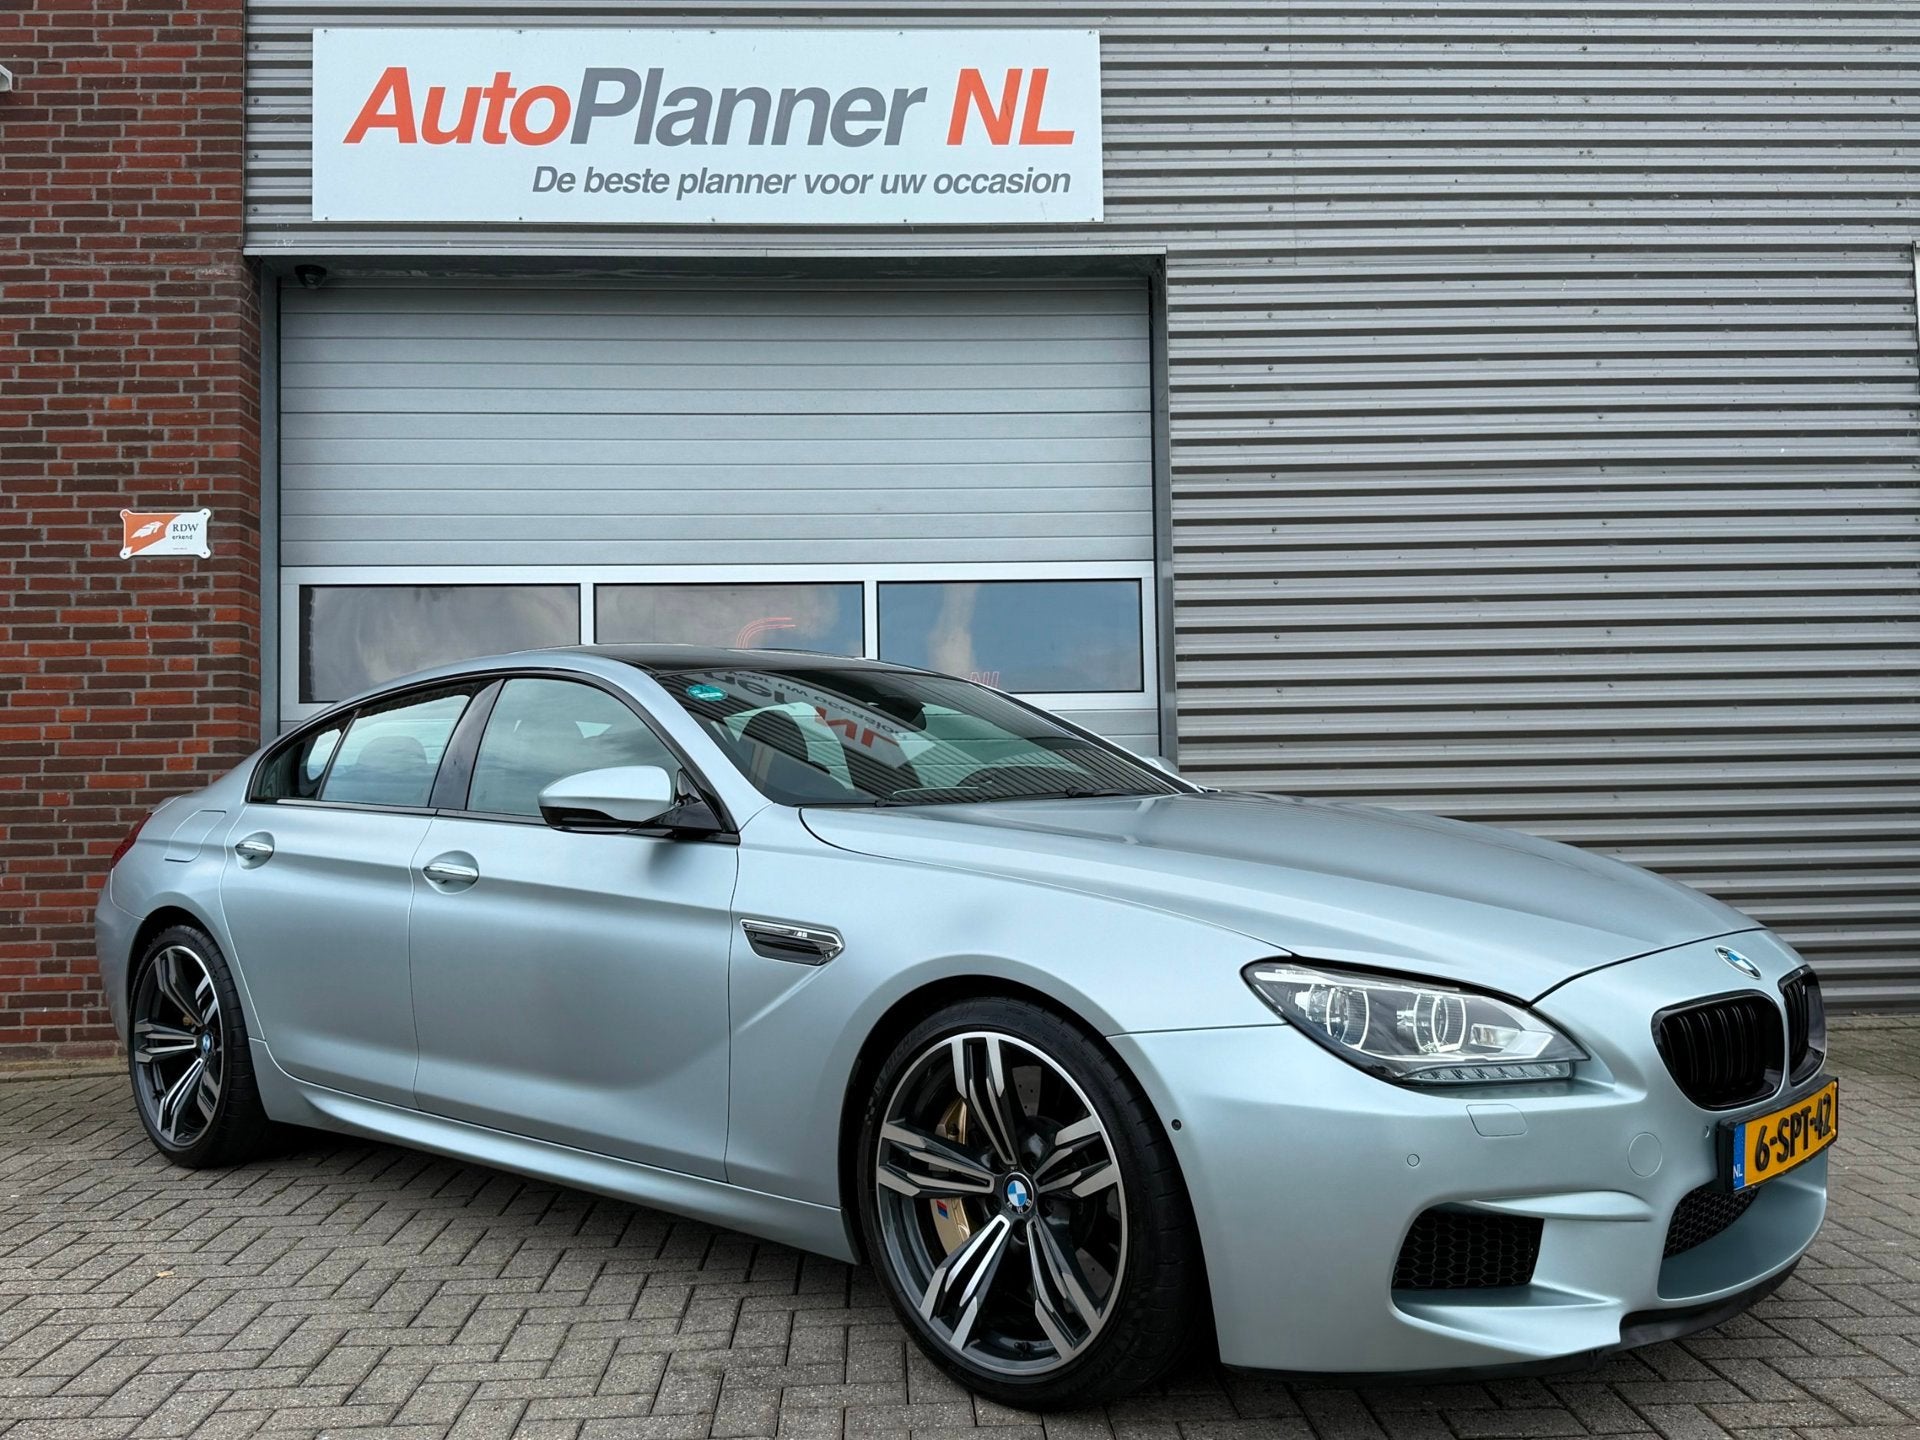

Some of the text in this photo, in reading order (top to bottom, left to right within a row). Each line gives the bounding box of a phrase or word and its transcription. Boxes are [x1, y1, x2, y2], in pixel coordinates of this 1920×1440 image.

[343, 67, 1074, 147] AutoPlanner NL
[533, 166, 1070, 200] De beste planner voor uw occasion
[172, 523, 199, 532] RDW
[1755, 1093, 1832, 1172] 6-SPT-42
[1733, 1163, 1743, 1179] NL
